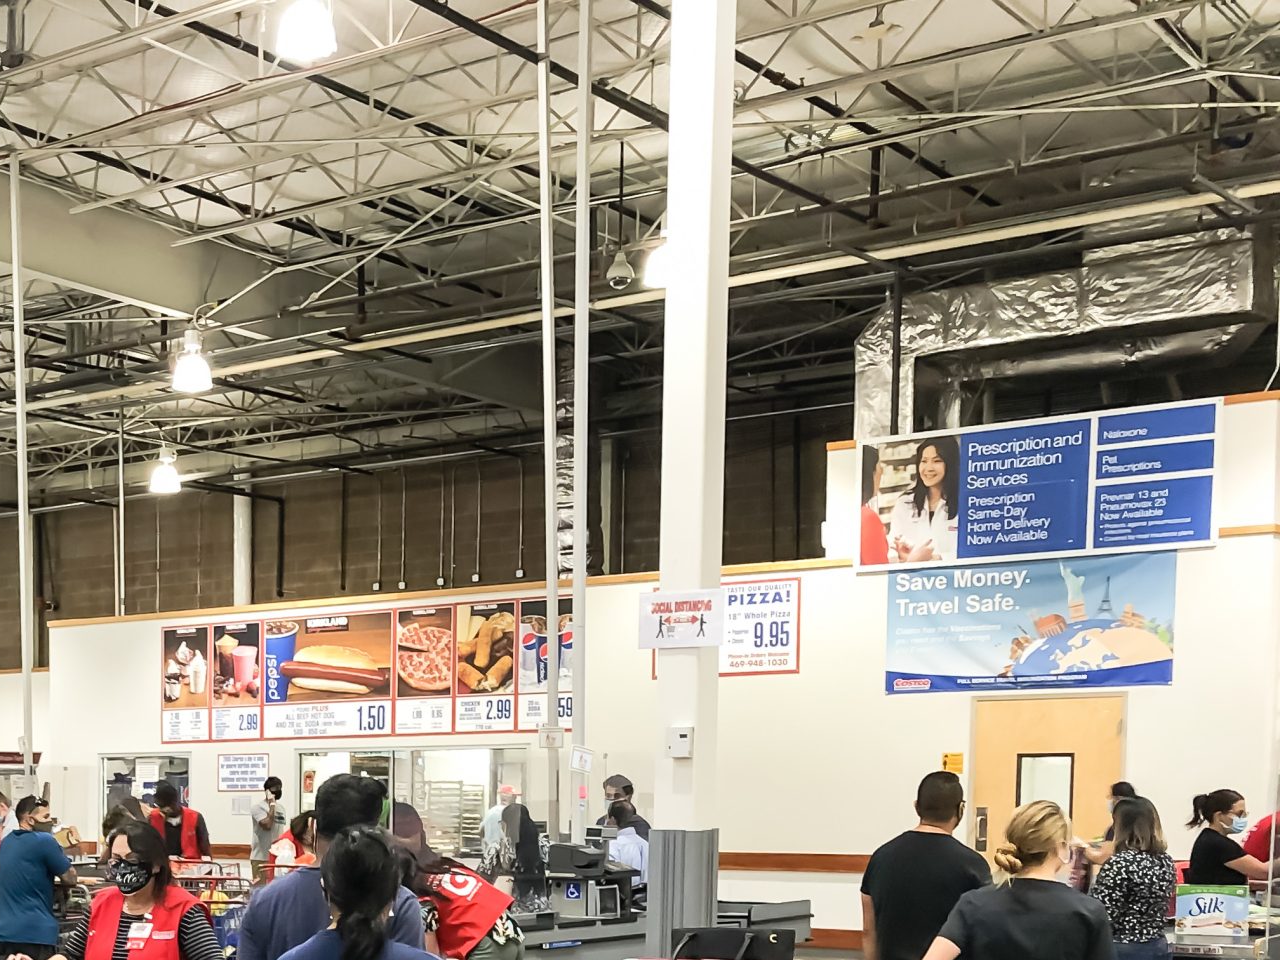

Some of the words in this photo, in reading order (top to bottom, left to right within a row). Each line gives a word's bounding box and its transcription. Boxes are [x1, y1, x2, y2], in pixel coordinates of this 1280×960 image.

[1103, 428, 1148, 439] Naloxone
[968, 437, 1051, 457] Prescription
[1053, 431, 1083, 448] and
[968, 452, 1062, 473] Immunization
[1102, 455, 1118, 464] Pet
[1102, 461, 1162, 473] Prescriptions
[967, 473, 1028, 489] Services
[968, 492, 1035, 507] Prescription
[1100, 493, 1135, 502] Prevnar
[1138, 490, 1149, 499] 13
[1150, 488, 1169, 497] and
[1154, 497, 1167, 507] 23
[967, 505, 1027, 520] Same-Day
[1100, 513, 1120, 521] Now
[1122, 508, 1163, 519] Available
[967, 521, 1001, 533] Home
[1004, 517, 1051, 530] Delivery
[967, 535, 993, 545] Now
[995, 530, 1048, 543] Available
[896, 573, 947, 592] Save
[953, 569, 1031, 590] Money.
[728, 590, 790, 606] PIZZA!
[896, 596, 959, 617] Travel
[966, 593, 1020, 613] Safe.
[651, 601, 673, 614] SOCIAL
[674, 599, 712, 612] DISTANCING
[744, 611, 767, 619] Whole
[771, 610, 791, 618] Pizza
[307, 617, 348, 628] KIRKLAND
[754, 621, 790, 648] 9.95
[266, 654, 279, 700] pepsi
[486, 699, 511, 720] 2.99
[238, 714, 258, 731] 2.99
[357, 705, 386, 731] 1.50
[1189, 897, 1224, 917] Silk
